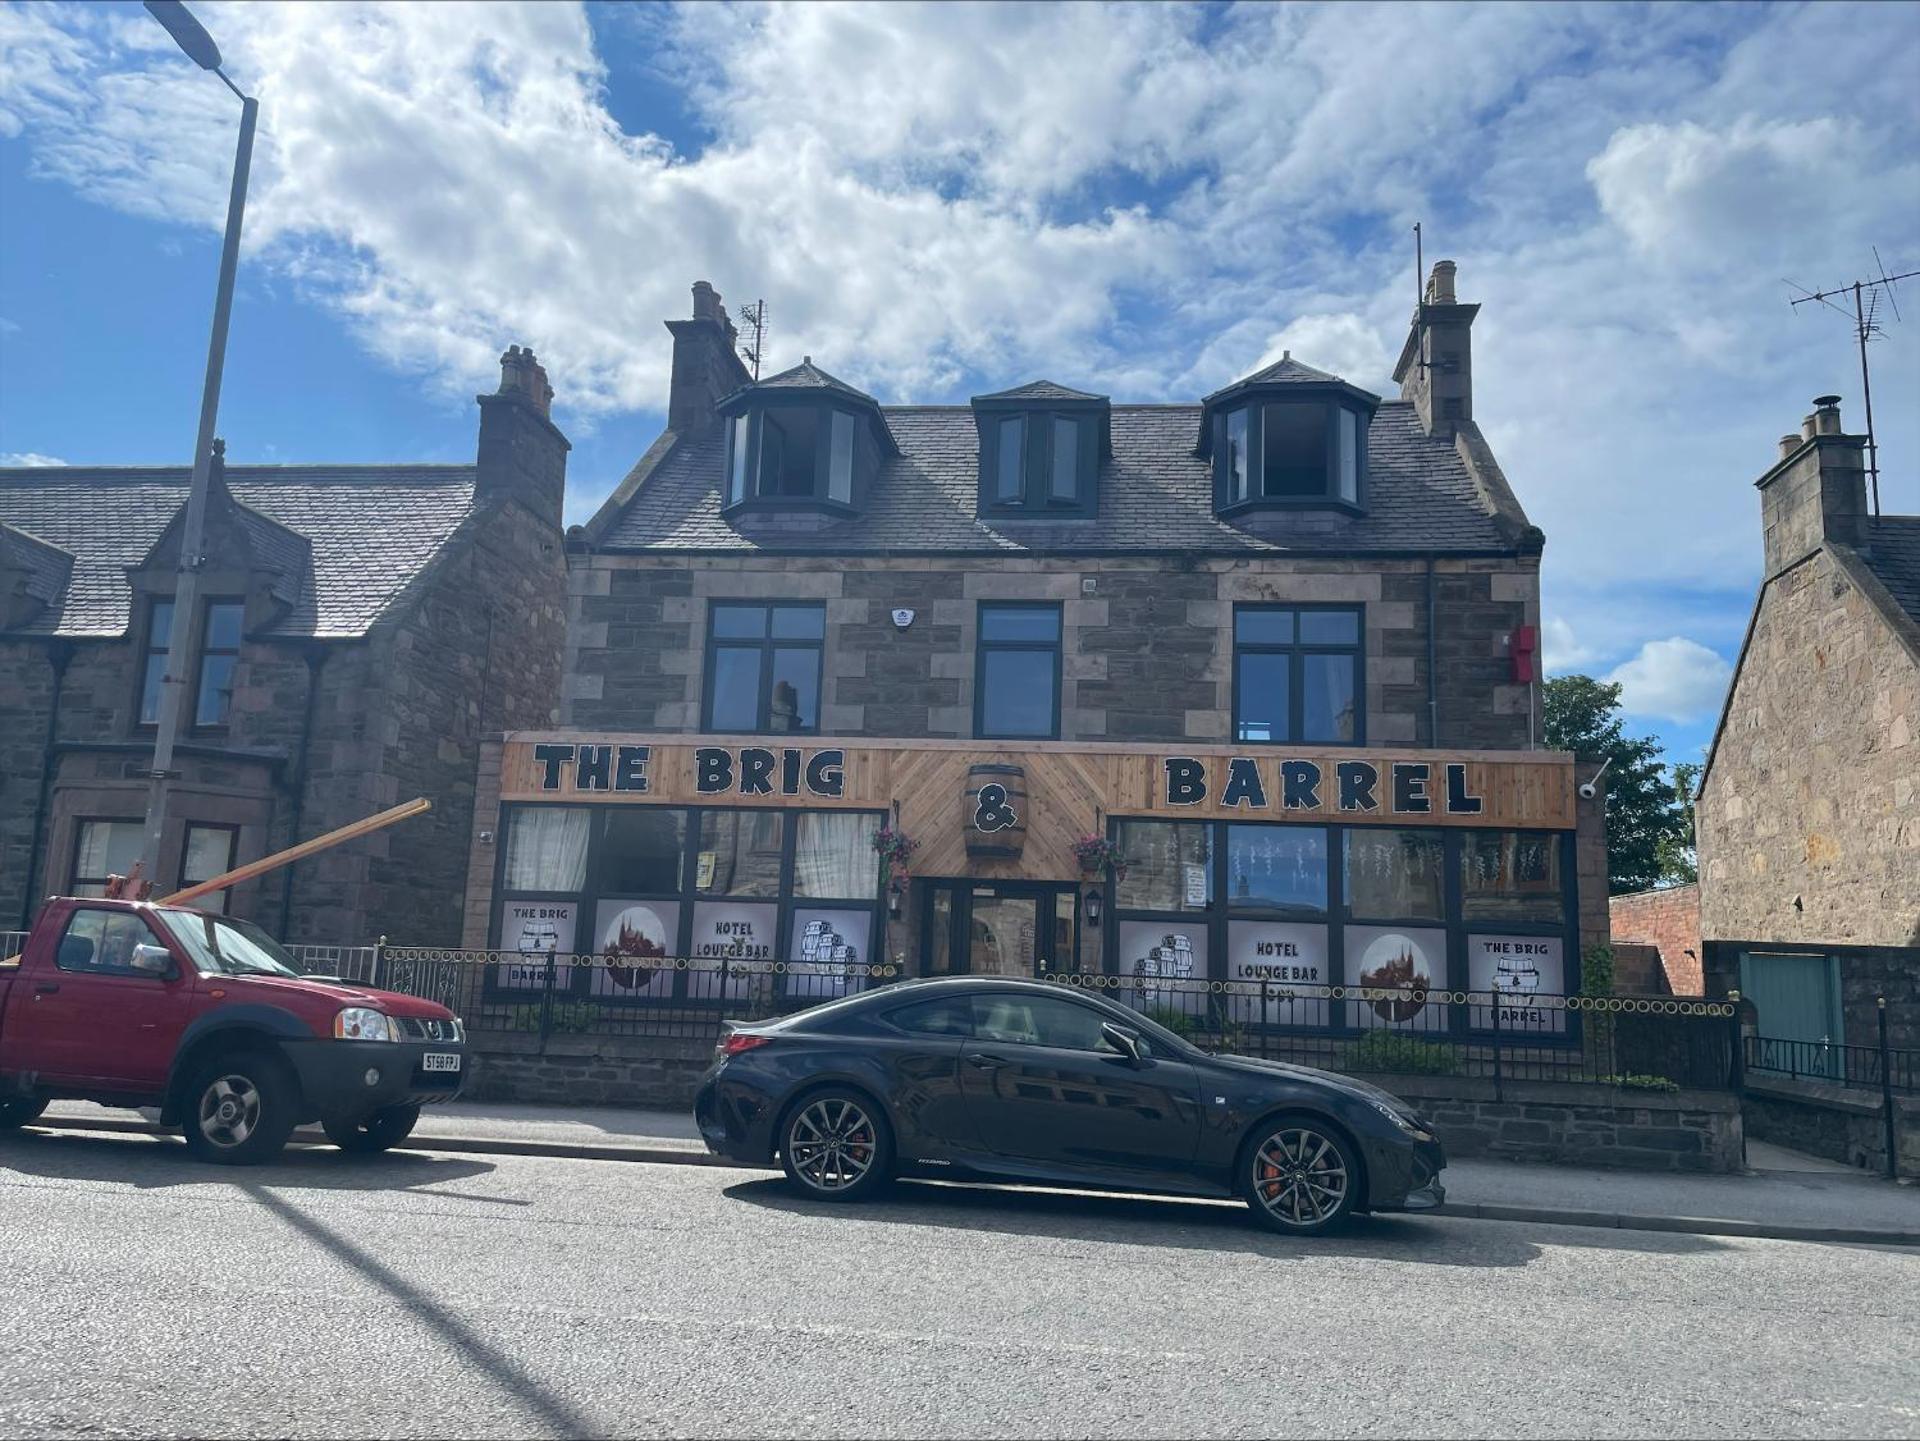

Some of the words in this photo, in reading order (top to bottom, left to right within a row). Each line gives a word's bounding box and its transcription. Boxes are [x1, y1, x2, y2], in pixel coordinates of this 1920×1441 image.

[535, 744, 650, 791] THE
[695, 747, 844, 798] BRIG
[973, 782, 1018, 833] &
[1164, 757, 1482, 814] BARREL
[513, 907, 536, 919] THE
[539, 908, 568, 920] BRIG
[716, 922, 753, 936] HOTEL
[1257, 942, 1298, 957] HOTEL
[1483, 942, 1510, 953] THE
[1514, 943, 1548, 955] BRIG
[1292, 966, 1318, 981] BAR
